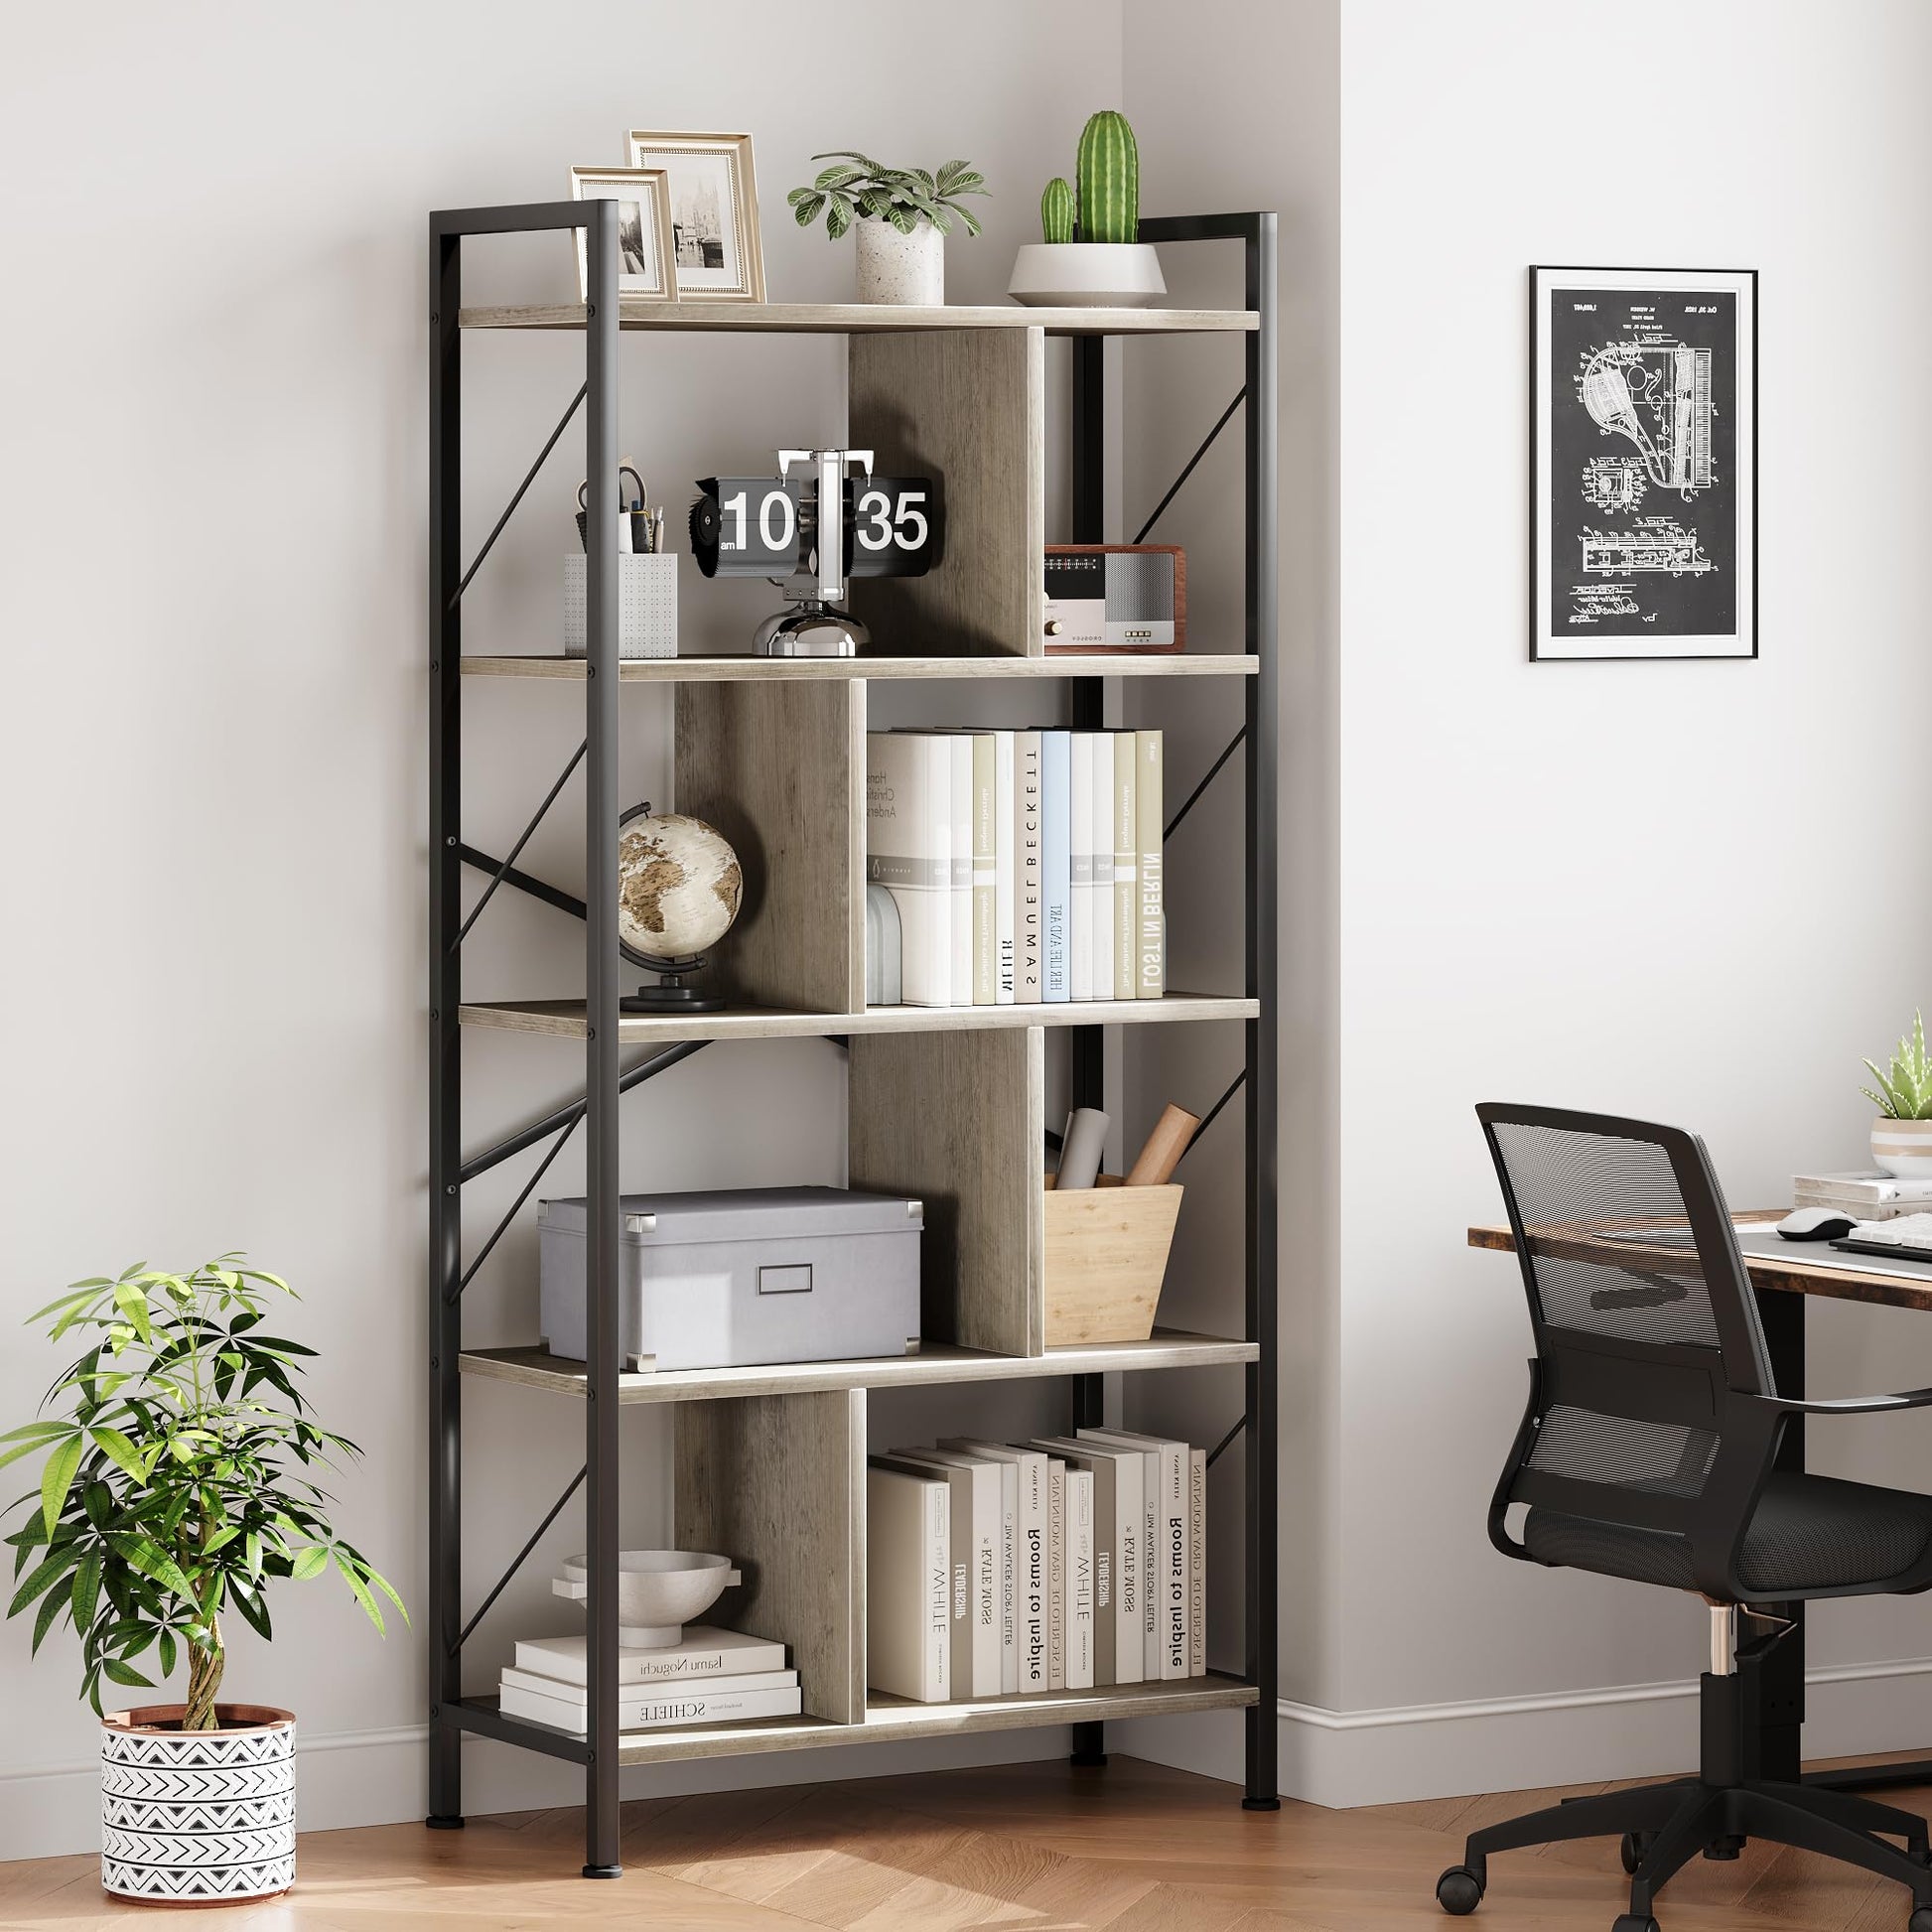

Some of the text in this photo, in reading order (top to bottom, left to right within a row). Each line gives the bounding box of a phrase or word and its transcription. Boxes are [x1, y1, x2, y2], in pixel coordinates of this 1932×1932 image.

[721, 542, 735, 550] am
[724, 491, 795, 551] 10
[857, 491, 928, 551] 35
